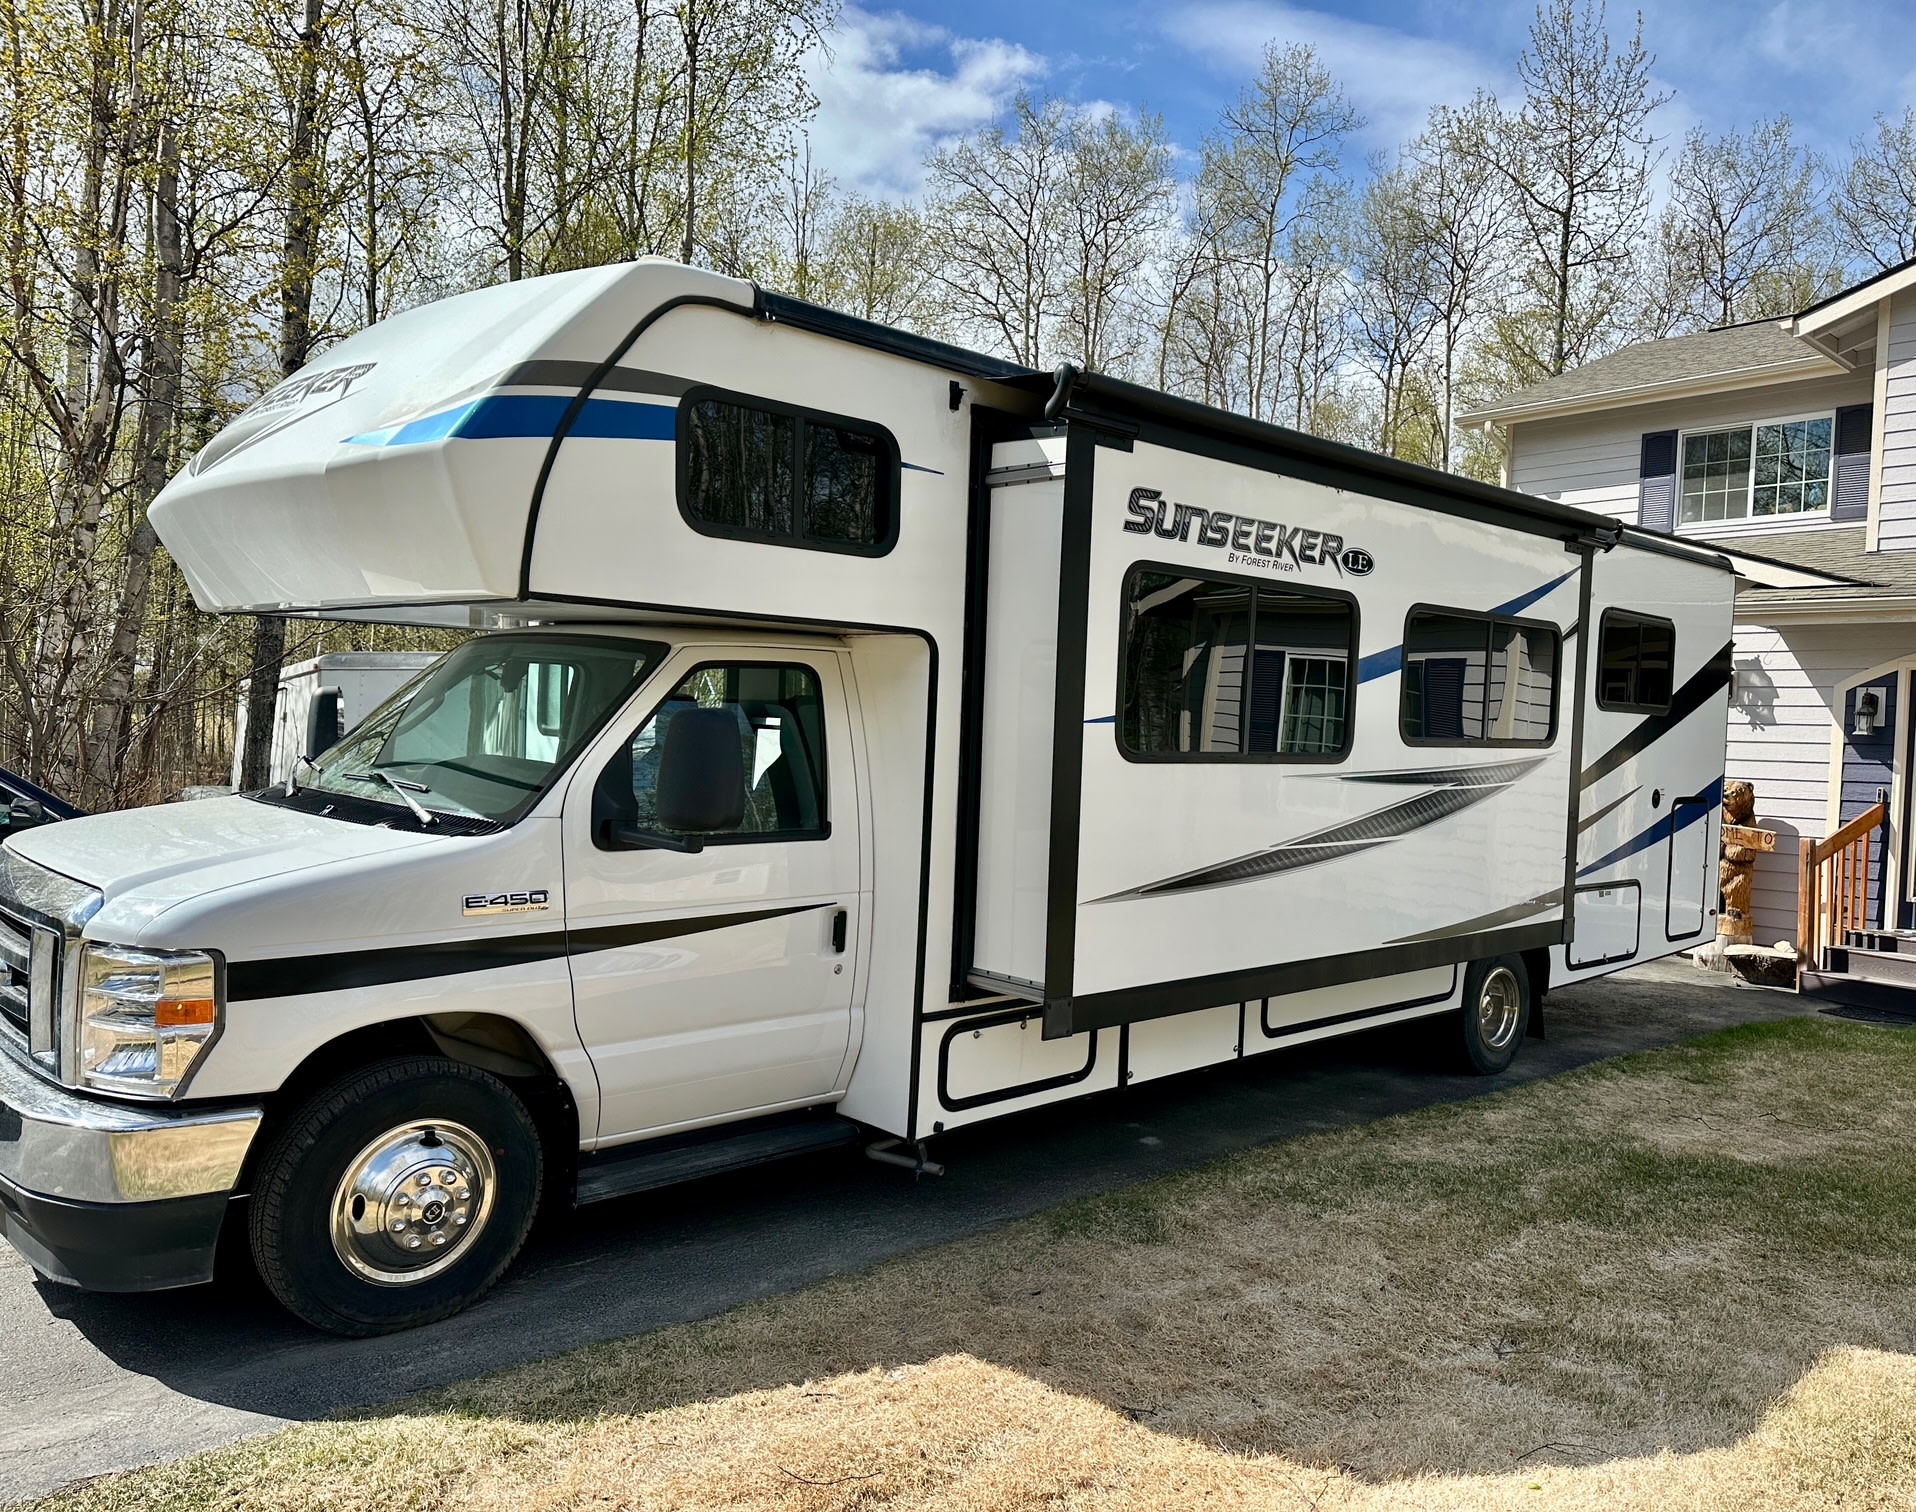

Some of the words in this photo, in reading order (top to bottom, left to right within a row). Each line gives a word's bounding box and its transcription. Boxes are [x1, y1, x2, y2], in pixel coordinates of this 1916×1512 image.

[1241, 554, 1271, 569] FOREST
[1272, 559, 1294, 573] RIVER
[1347, 552, 1369, 572] LE
[464, 891, 549, 909] E-450
